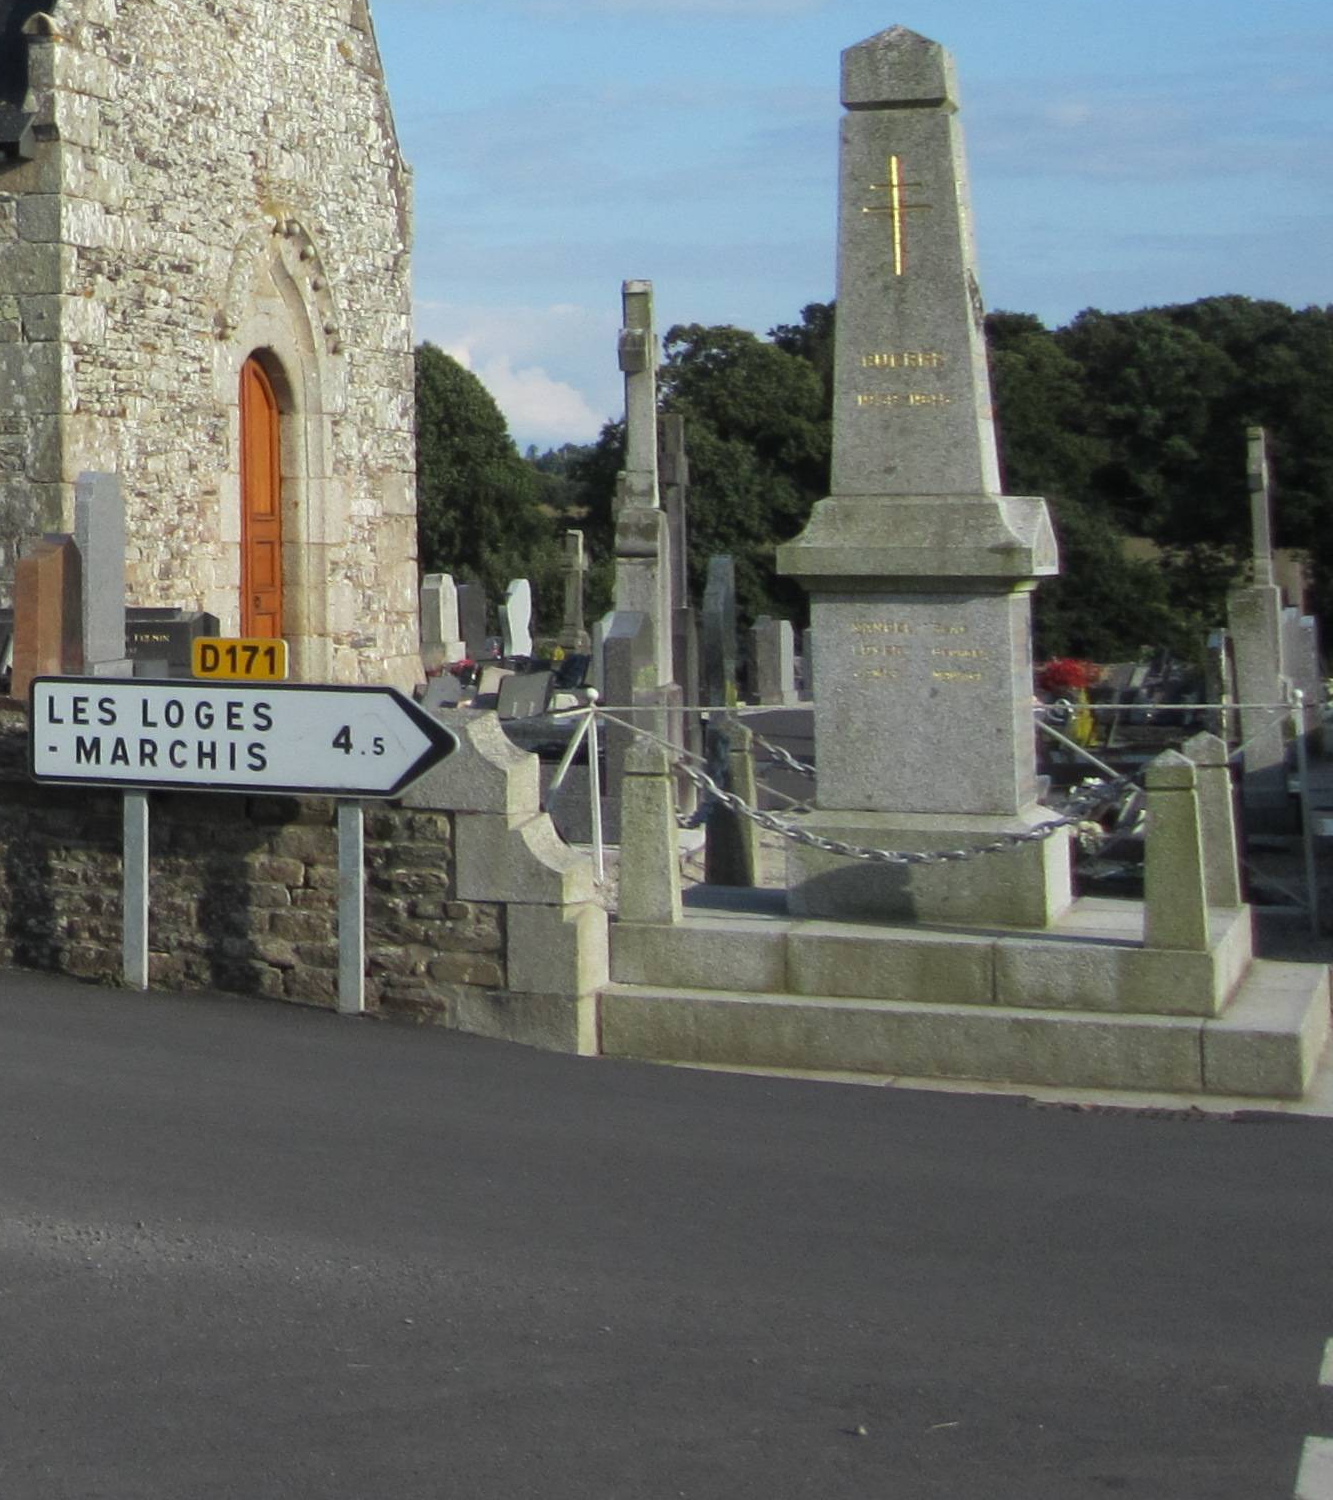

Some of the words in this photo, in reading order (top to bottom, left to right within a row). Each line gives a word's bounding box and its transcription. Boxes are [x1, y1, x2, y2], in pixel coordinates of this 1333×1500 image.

[200, 644, 276, 675] D171
[48, 695, 117, 726] LES
[141, 698, 273, 732] LOGES
[332, 725, 385, 756] 4.5
